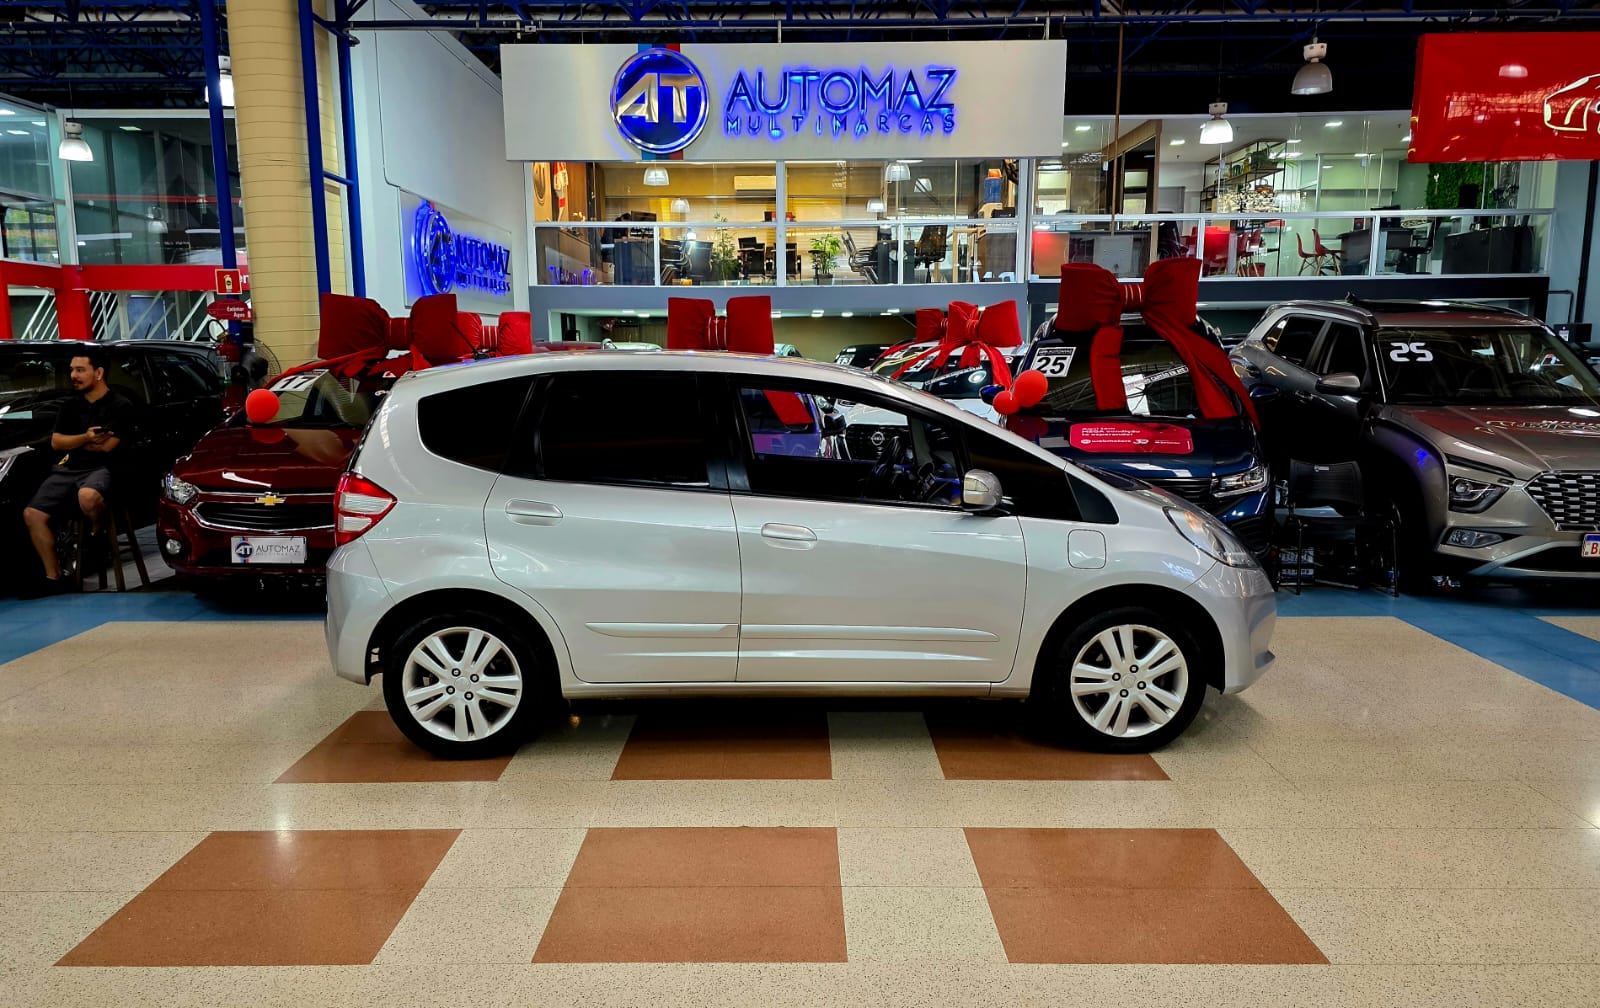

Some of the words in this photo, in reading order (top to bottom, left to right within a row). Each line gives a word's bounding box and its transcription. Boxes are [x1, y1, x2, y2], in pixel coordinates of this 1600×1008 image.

[616, 72, 701, 123] AT
[726, 69, 957, 113] AUTOMAZ
[726, 113, 956, 136] MULTIMARCAS
[453, 233, 511, 276] AUTOMAZ
[1390, 342, 1434, 362] 25
[1037, 356, 1068, 375] 25
[256, 544, 300, 553] AUTOMAZ
